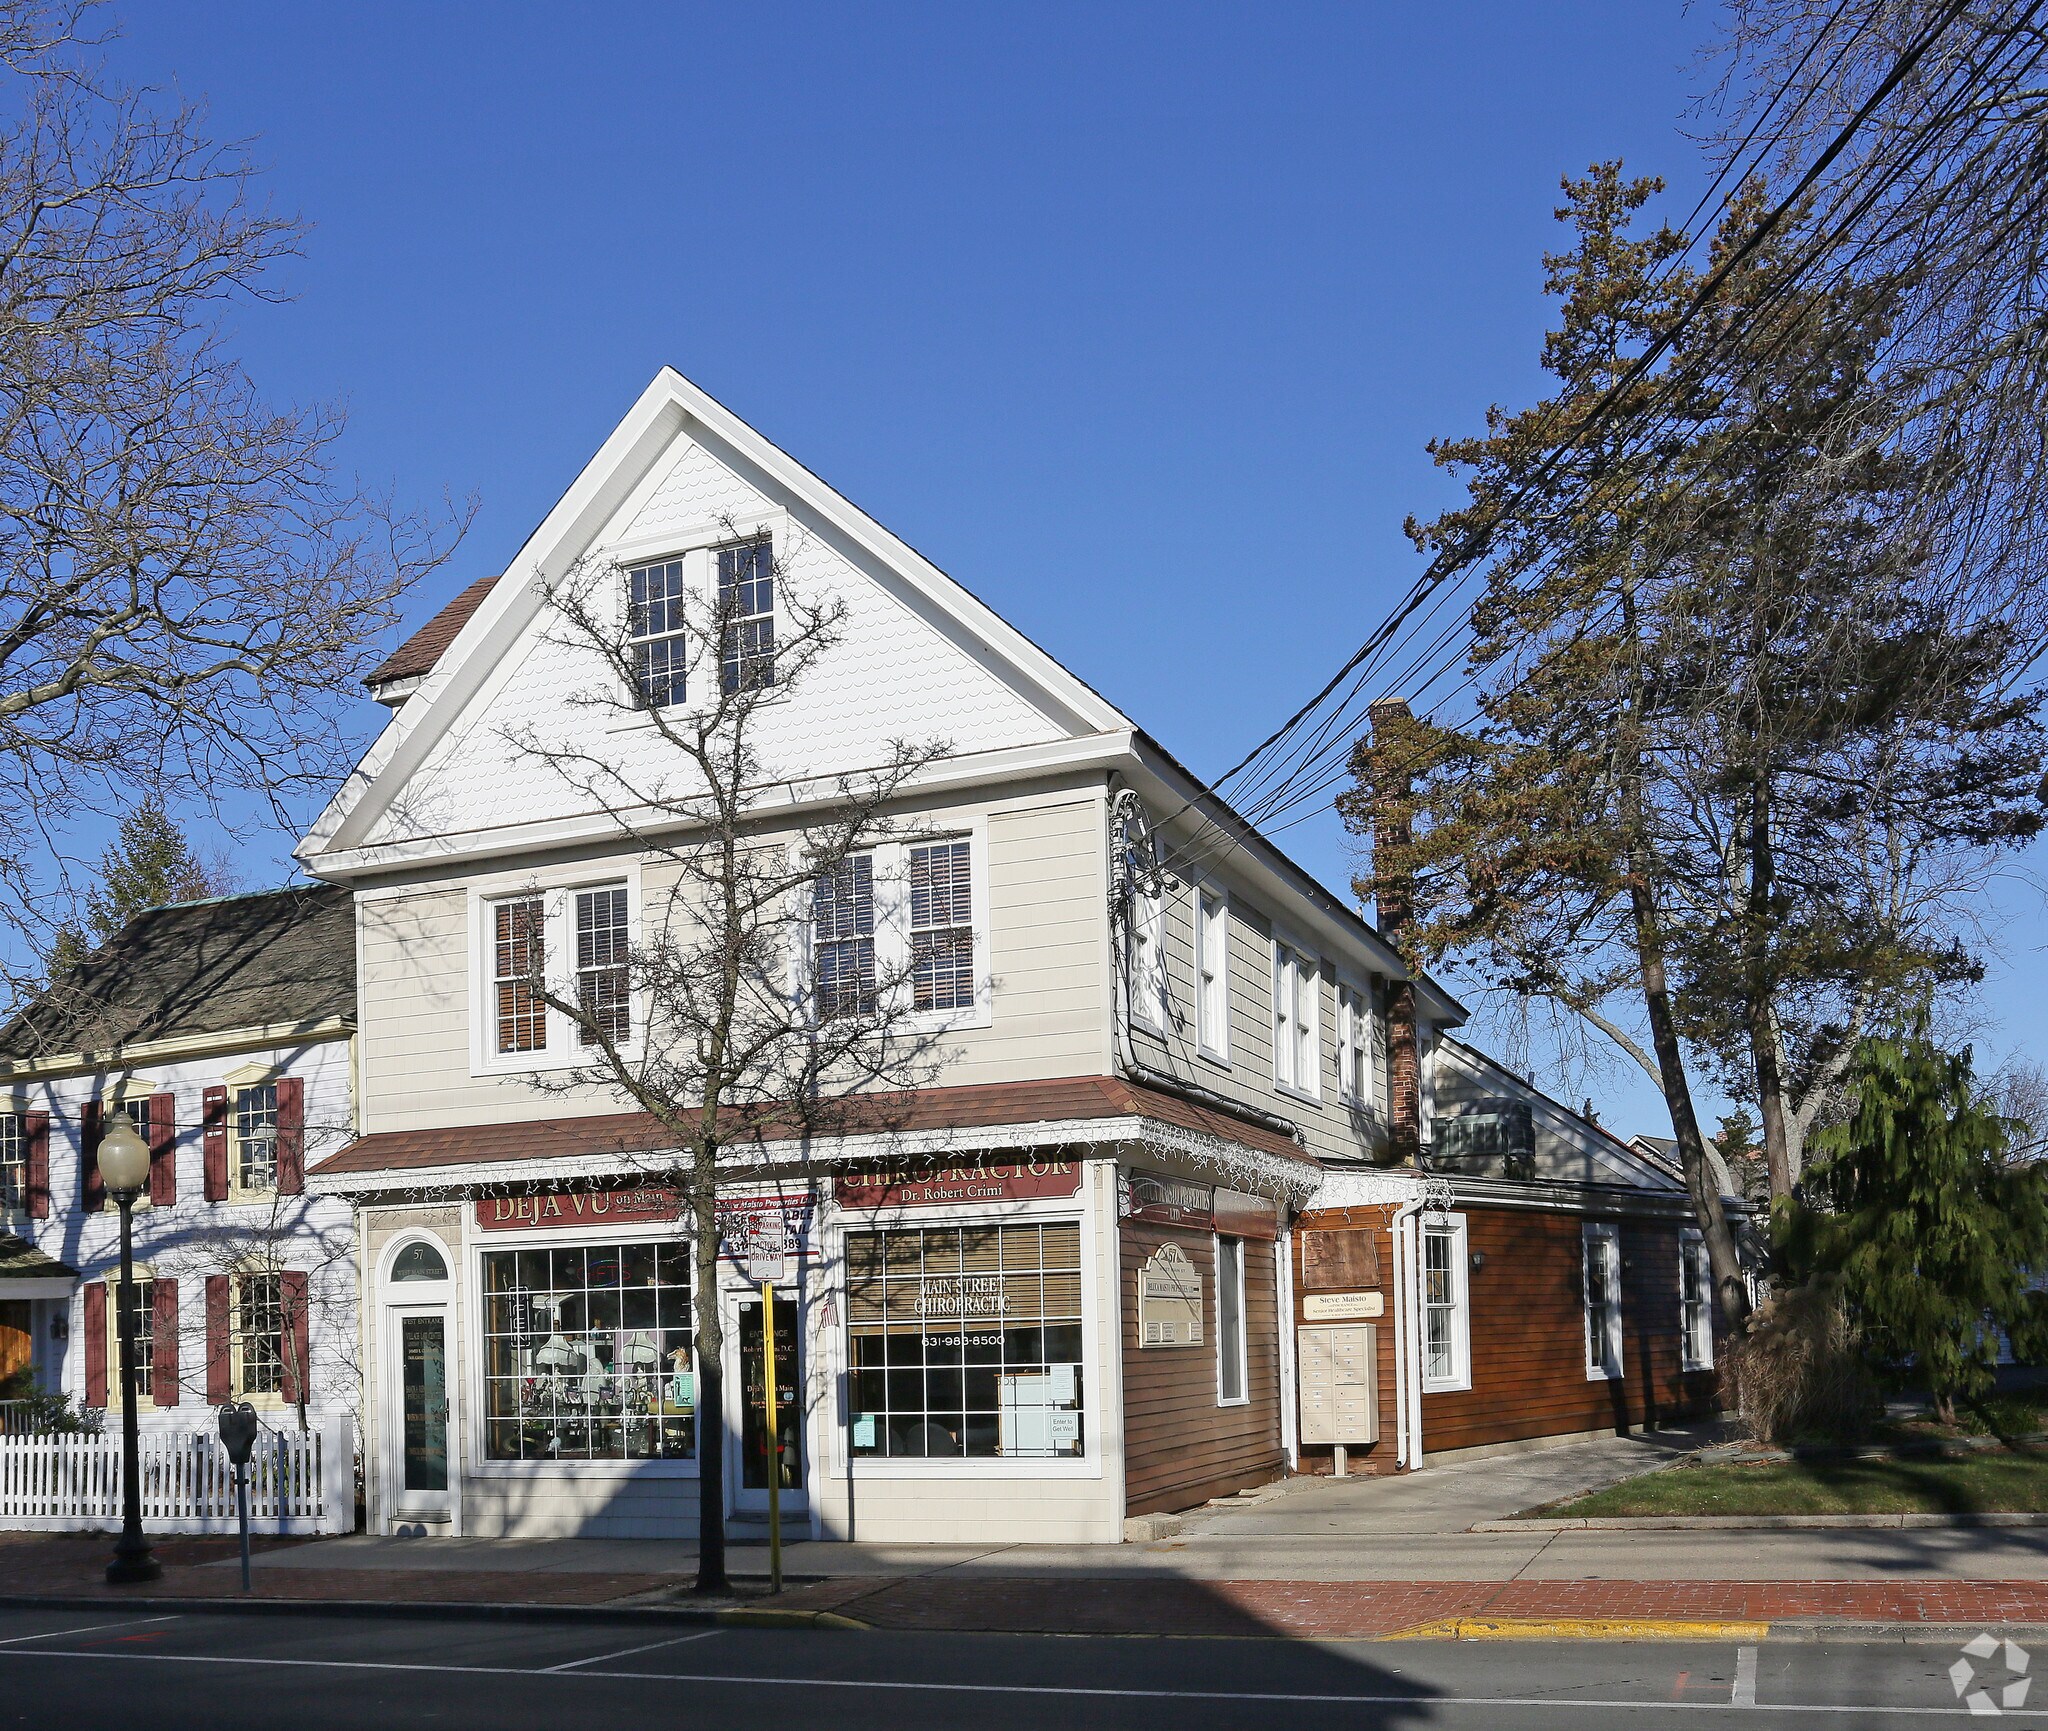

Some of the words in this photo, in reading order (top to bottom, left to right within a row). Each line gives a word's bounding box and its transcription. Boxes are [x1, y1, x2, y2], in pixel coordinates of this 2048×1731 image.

[843, 1152, 1073, 1188] CHIROPRACTOR
[901, 1189, 920, 1202] Dr.
[923, 1186, 964, 1201] Robert
[967, 1182, 1003, 1198] Crimi
[494, 1193, 563, 1226] DEJA
[570, 1188, 611, 1215] VU
[616, 1194, 630, 1206] on
[765, 1197, 799, 1208] Properties
[759, 1221, 781, 1230] PARKING
[413, 1248, 424, 1260] 57
[752, 1252, 782, 1262] DRIVEWAY
[1168, 1247, 1177, 1264] 57
[576, 1263, 631, 1281] GFTS
[919, 1279, 952, 1295] MAIN
[955, 1276, 1006, 1294] STREET
[913, 1295, 1011, 1314] CHIROPRACTIC
[1319, 1296, 1340, 1304] Steve
[1342, 1295, 1367, 1303] Maisto
[749, 1329, 788, 1338] ENTNCE
[921, 1335, 1006, 1347] 631-983-8500
